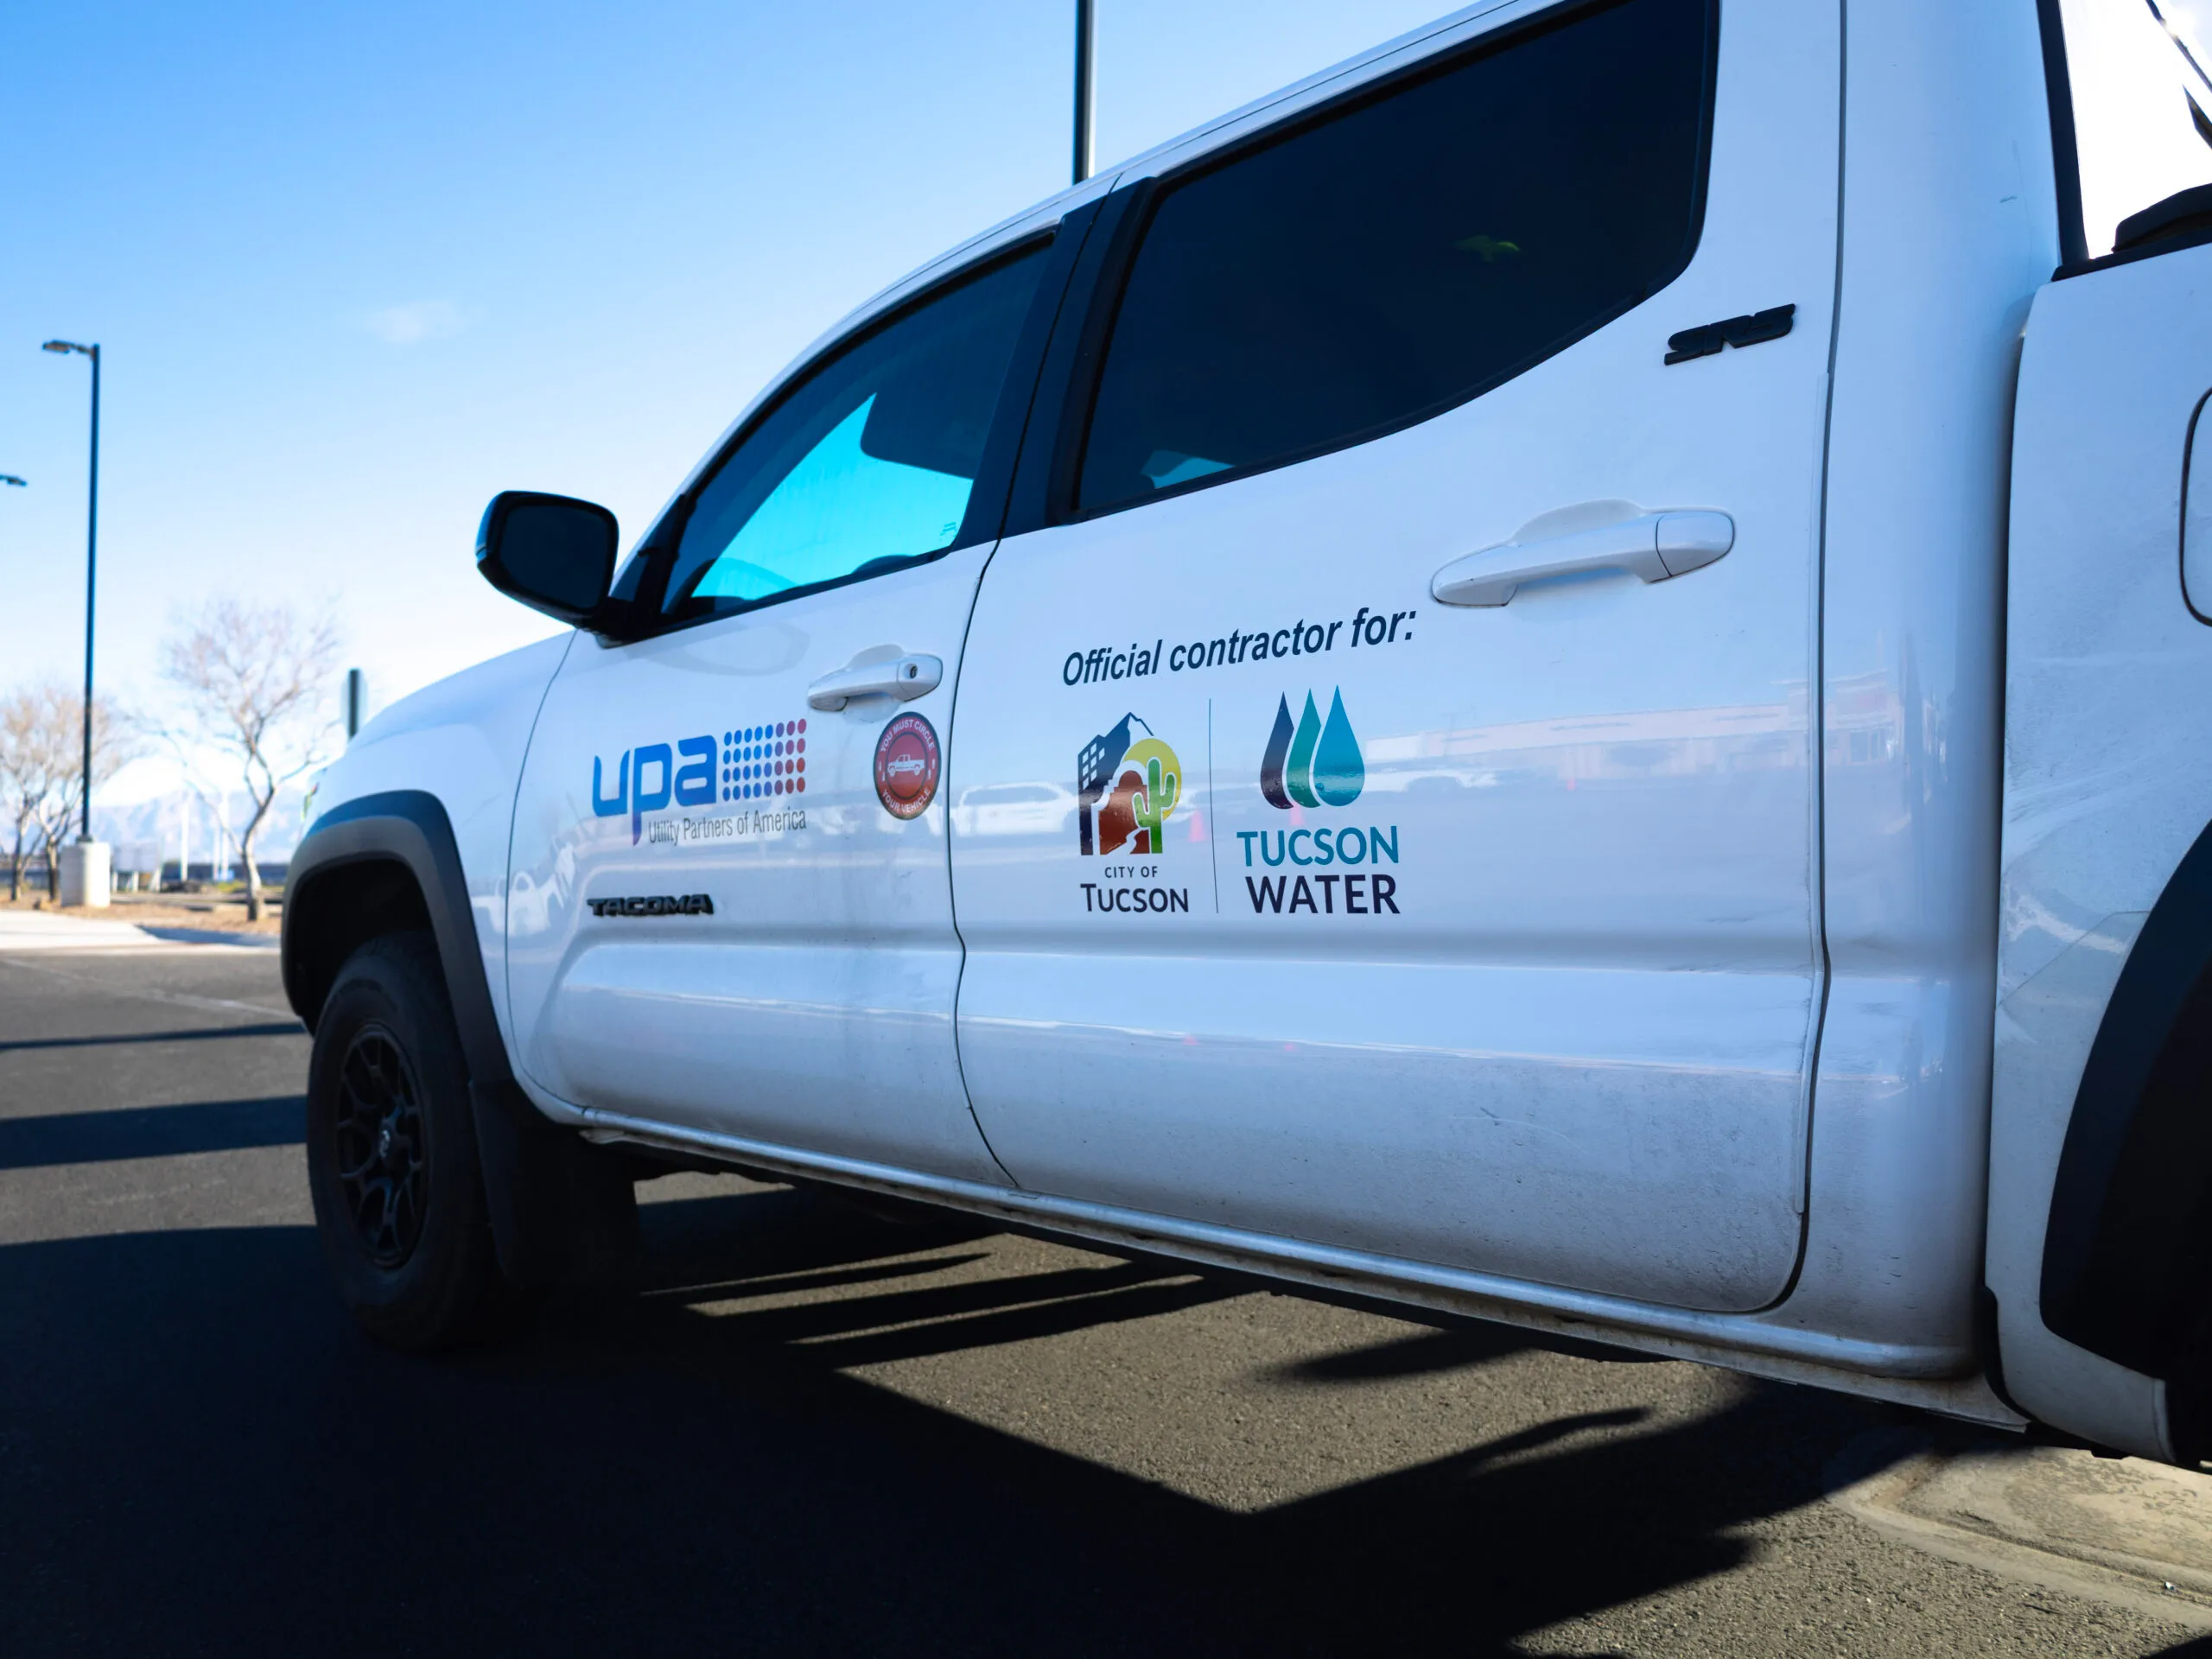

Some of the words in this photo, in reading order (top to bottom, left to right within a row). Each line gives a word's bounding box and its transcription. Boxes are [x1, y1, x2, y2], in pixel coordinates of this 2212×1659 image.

[1063, 639, 1163, 686] Official
[1169, 619, 1343, 671] contractor
[1351, 607, 1417, 649] for:
[880, 732, 893, 753] YOU
[893, 720, 914, 734] MUST
[914, 721, 935, 752] CIRCLE
[593, 735, 716, 846] upa
[882, 788, 900, 812] YOUR
[900, 787, 931, 813] VEHICLE
[649, 819, 679, 846] Utility
[683, 817, 733, 839] Partners
[737, 811, 749, 835] of
[753, 805, 807, 834] America
[1237, 826, 1399, 867] TUCSON
[1104, 867, 1135, 879] CITY
[1141, 866, 1158, 878] OF
[587, 893, 715, 917] TACOMA
[1245, 874, 1401, 914] WATER
